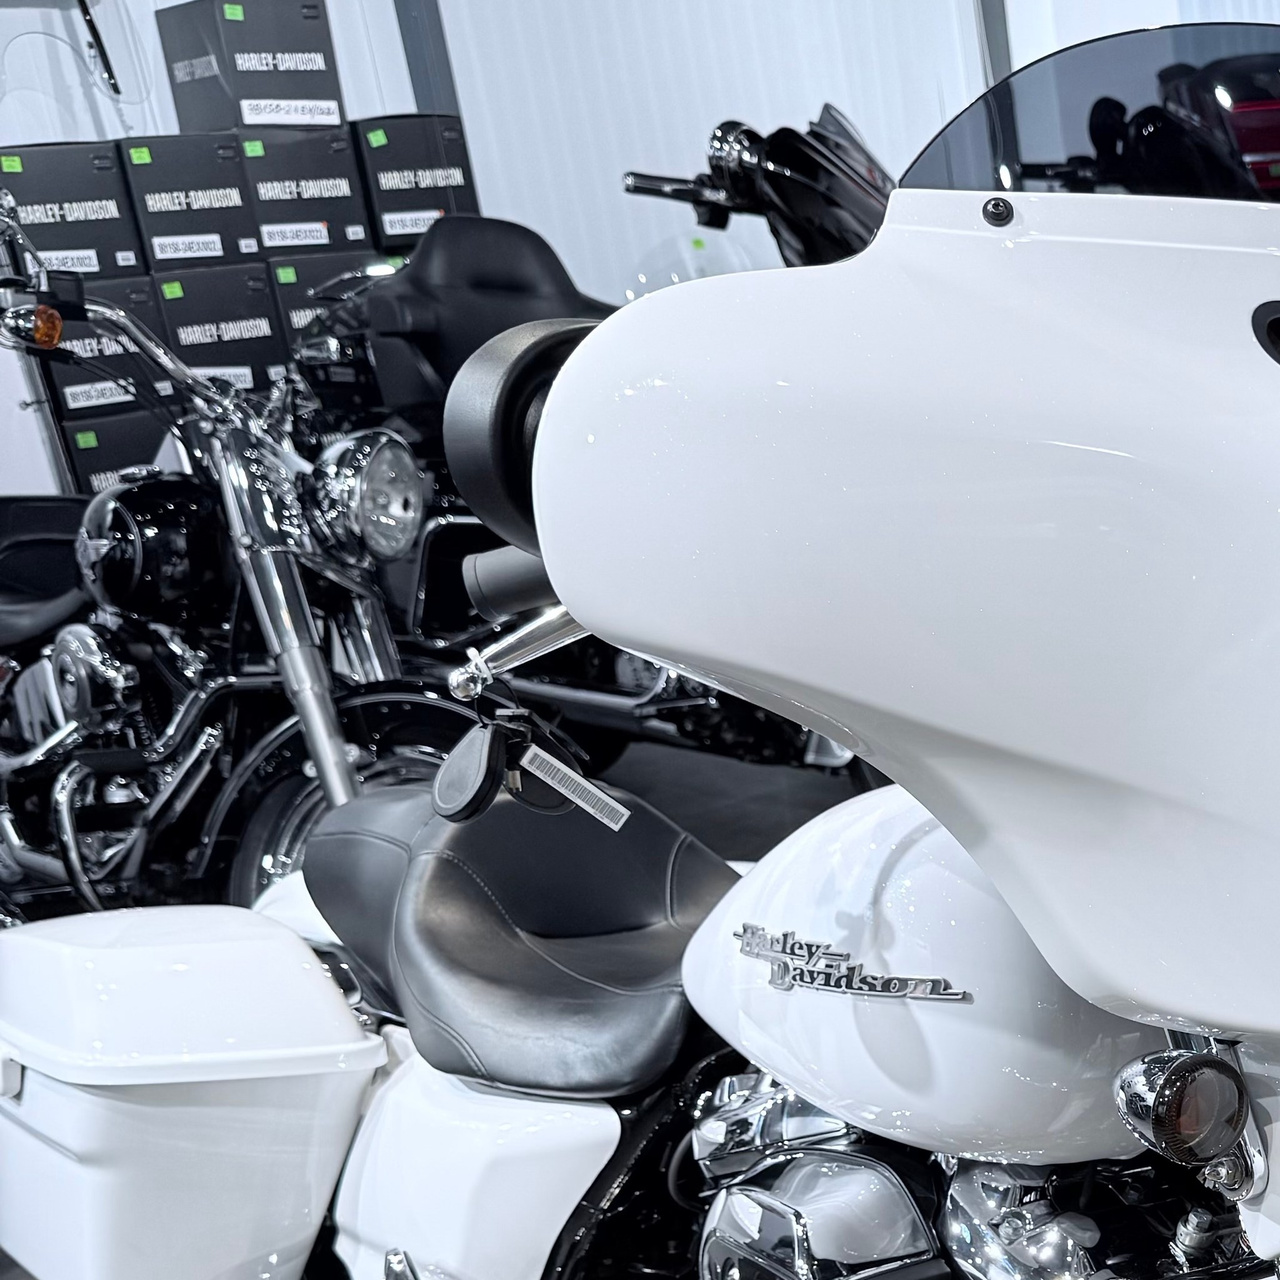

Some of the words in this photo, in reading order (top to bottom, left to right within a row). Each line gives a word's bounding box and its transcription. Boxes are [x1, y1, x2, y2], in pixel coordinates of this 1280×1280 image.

[234, 53, 326, 71] HARLEY-DAVIDSON
[256, 178, 351, 201] HARLEY-DAVIDSON
[376, 167, 465, 190] HARLEY-DAVIDSON
[144, 187, 242, 213] HARLEY-DAVIDSON
[176, 317, 272, 346] HARLEY-DAVIDSON
[768, 957, 967, 1001] Davidson
